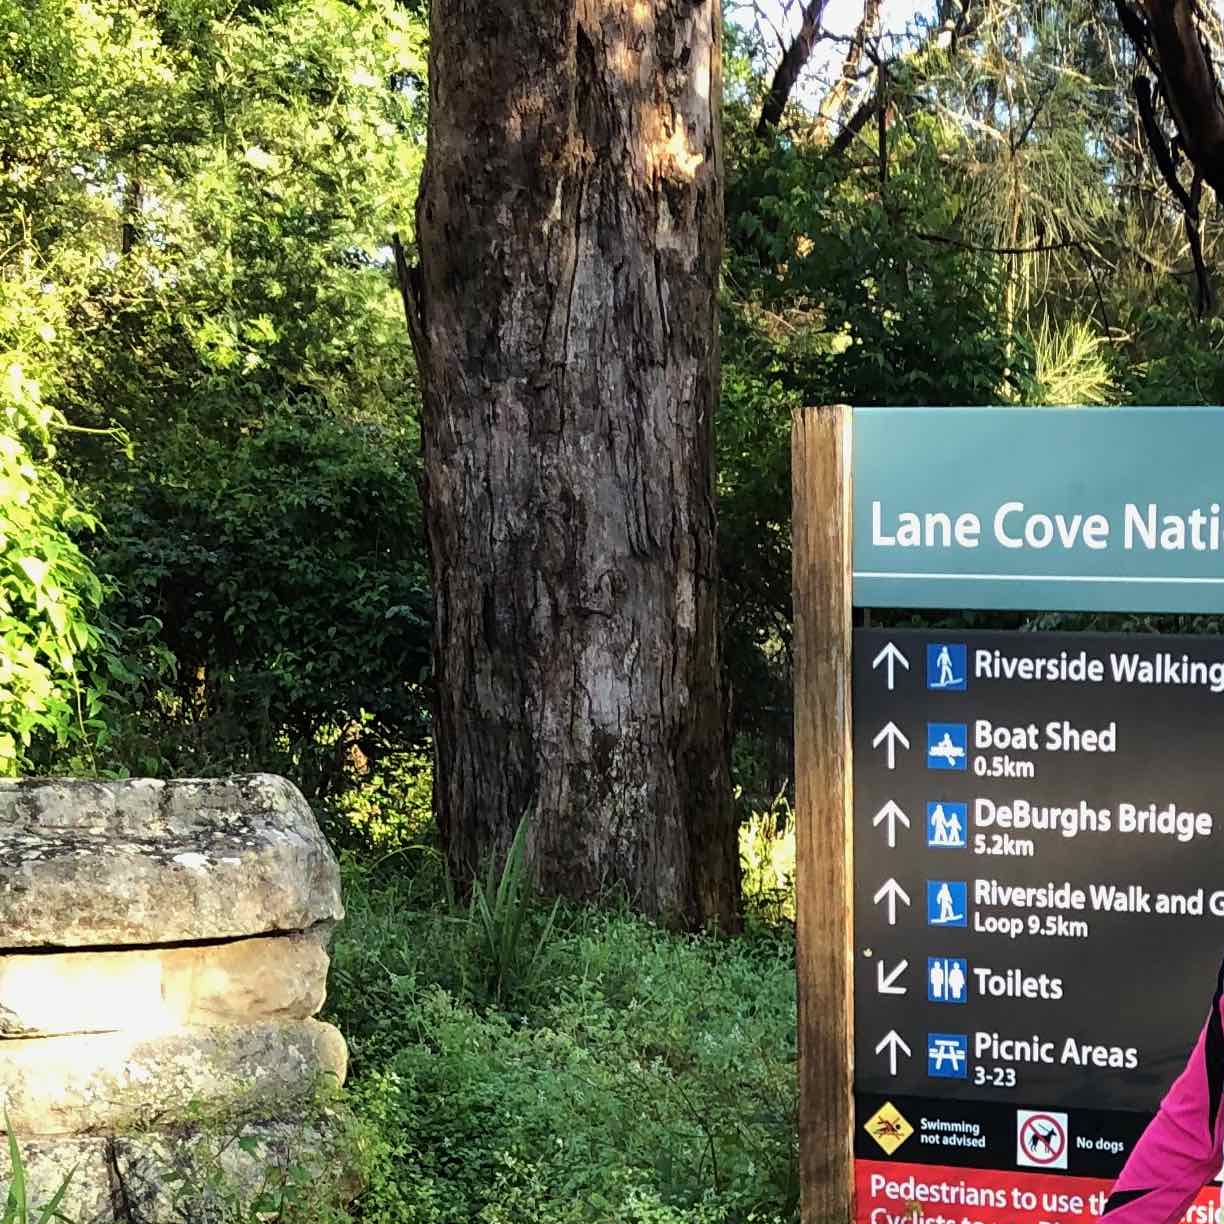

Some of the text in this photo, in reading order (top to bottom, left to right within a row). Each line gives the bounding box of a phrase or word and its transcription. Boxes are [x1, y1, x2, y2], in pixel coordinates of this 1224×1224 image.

[872, 502, 979, 547] Lane
[993, 502, 1109, 549] Cove
[975, 650, 1103, 681] Riverside
[975, 720, 1117, 752] Boat Shed
[974, 757, 1035, 777] 0.5km
[975, 798, 1213, 840] DeBurghs Bridge
[974, 834, 1034, 856] 5.2km
[975, 880, 1084, 910] Riverside
[1089, 885, 1151, 913] Walk
[1155, 887, 1204, 916] and
[974, 912, 1088, 938] Loop 9.5km
[974, 968, 1063, 1000] Toilets
[975, 1032, 1138, 1069] Picnic Areas
[974, 1066, 1016, 1087] 3-23
[920, 1118, 980, 1134] Swimming
[920, 1133, 986, 1148] not advised
[1076, 1136, 1124, 1152] No dogs
[870, 1174, 1109, 1216] Pedestrians to use th
